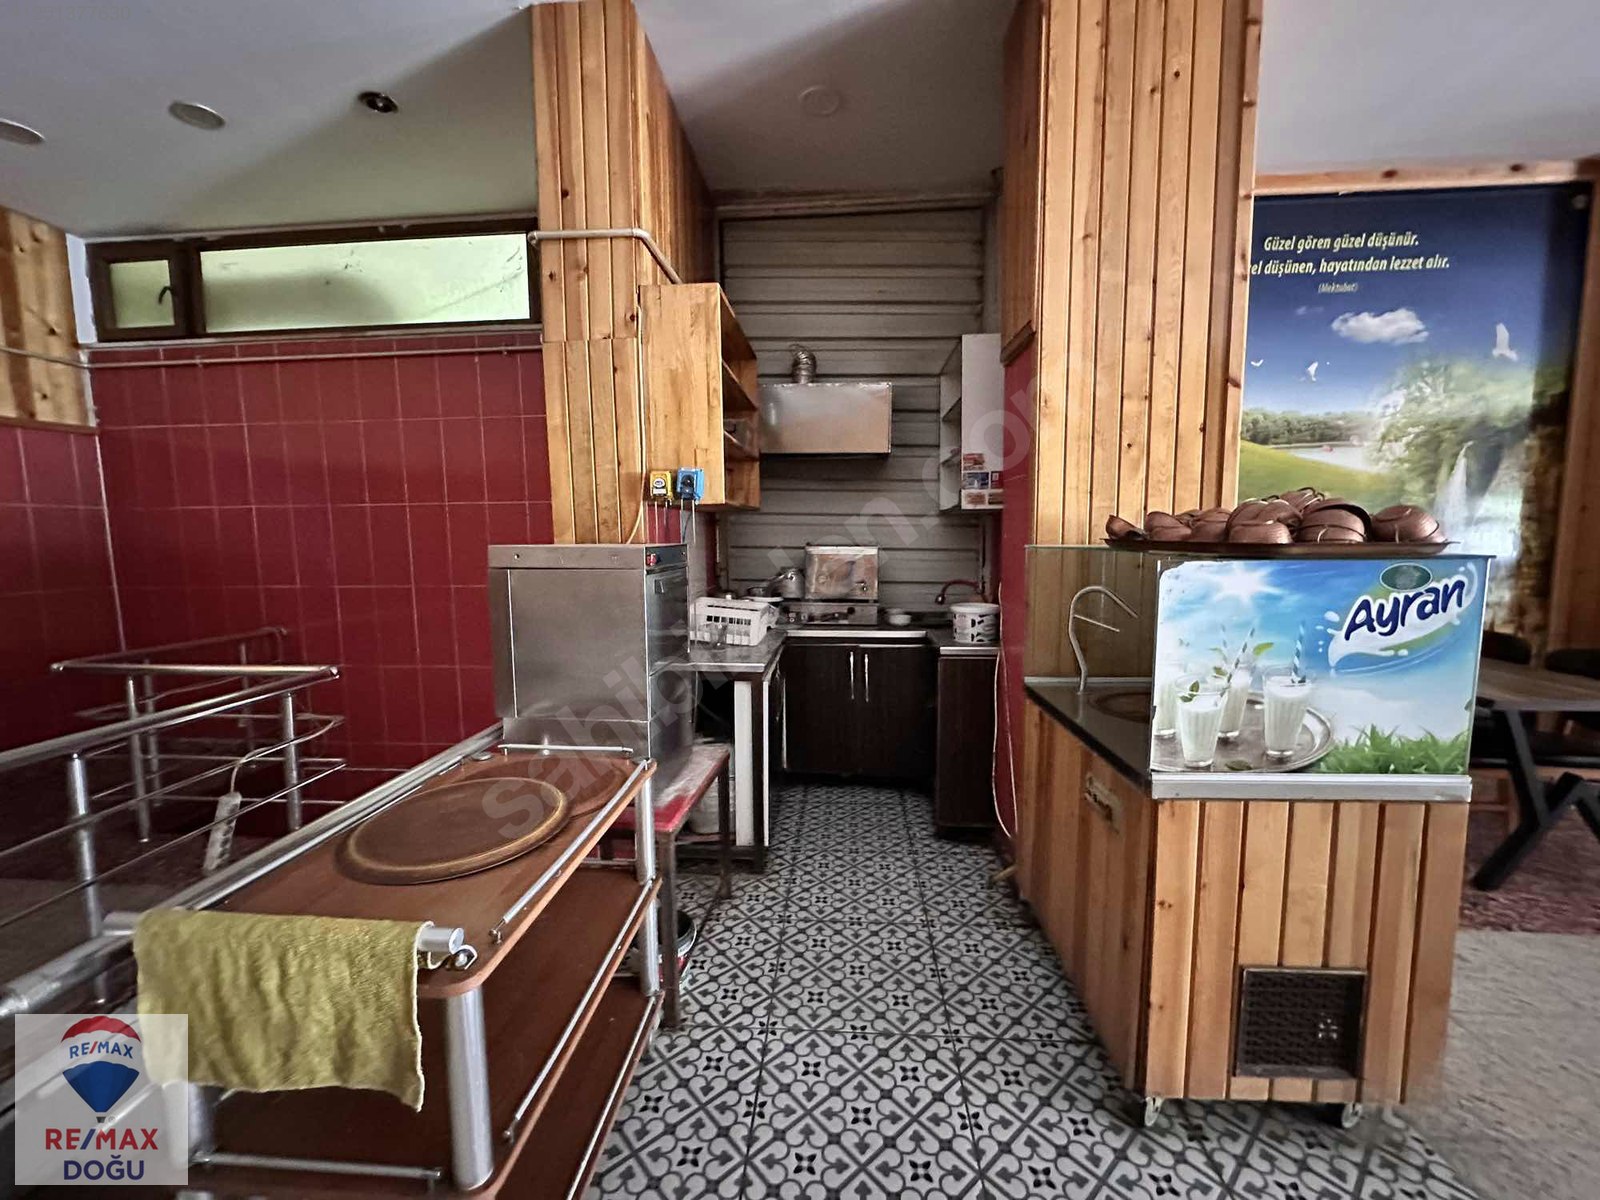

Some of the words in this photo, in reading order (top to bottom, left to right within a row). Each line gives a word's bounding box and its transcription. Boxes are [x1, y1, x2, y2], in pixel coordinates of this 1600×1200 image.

[1263, 236, 1296, 251] Güzel
[1297, 235, 1331, 254] gören
[1332, 233, 1366, 253] güzel
[1367, 231, 1419, 251] düşünür.
[1248, 260, 1263, 275] el
[1264, 259, 1317, 278] düşünen,
[1319, 256, 1388, 276] hayatından
[1389, 255, 1424, 271] lezzet
[1425, 253, 1450, 269] alır.
[1344, 579, 1466, 641] Ayran
